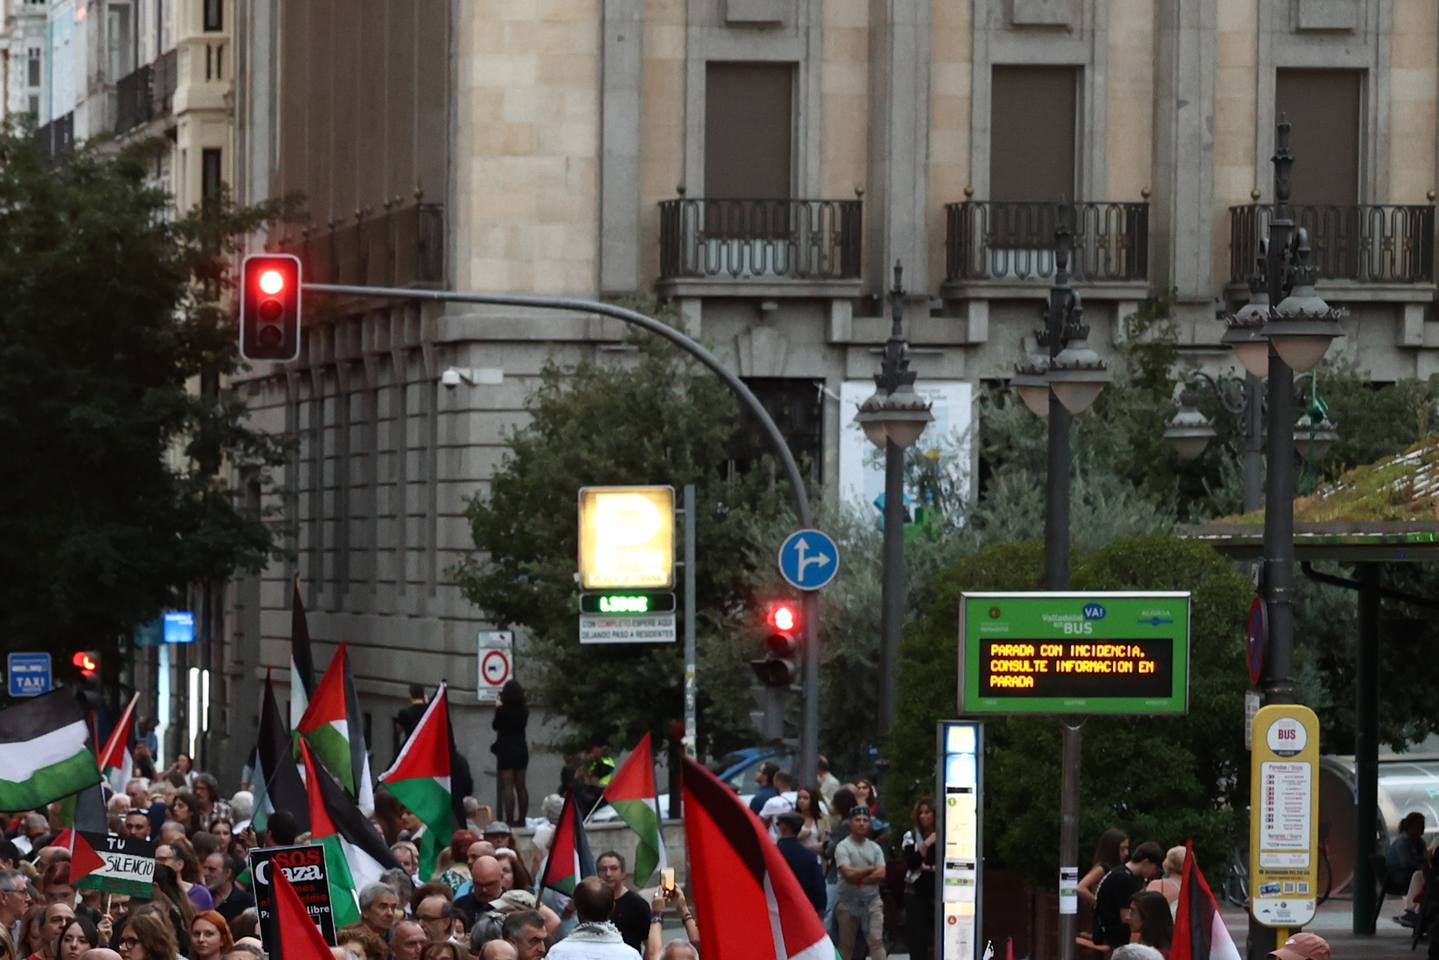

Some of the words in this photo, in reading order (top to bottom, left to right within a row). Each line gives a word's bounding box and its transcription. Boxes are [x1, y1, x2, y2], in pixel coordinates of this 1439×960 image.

[1085, 605, 1103, 617] VA!
[1064, 622, 1093, 634] BUS
[990, 644, 1035, 657] PARADA
[1040, 644, 1063, 657] CON
[990, 660, 1048, 673] CONSULTE
[1056, 660, 1133, 673] INFORMACION
[1138, 661, 1154, 673] EN
[16, 677, 45, 688] TAXI
[990, 675, 1034, 688] PARADA
[1278, 729, 1296, 740] BUS
[107, 838, 126, 849] TU
[275, 850, 321, 867] SOS
